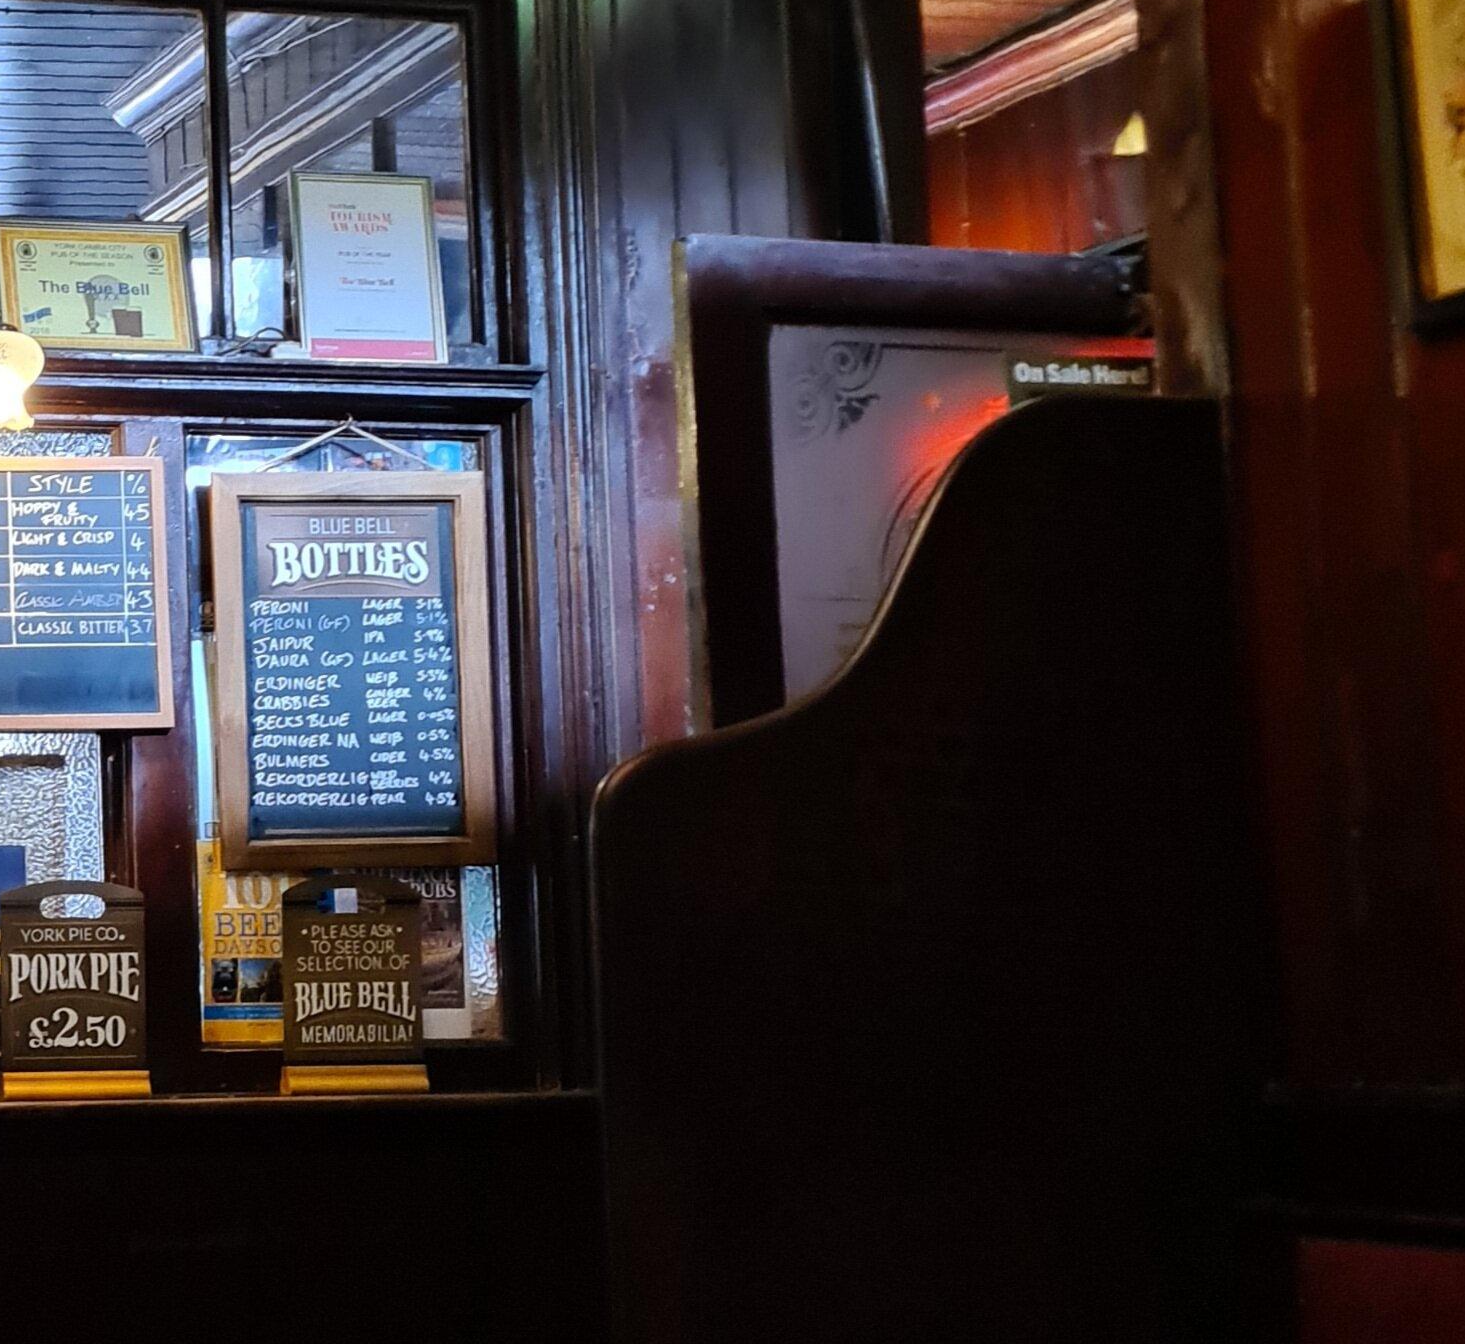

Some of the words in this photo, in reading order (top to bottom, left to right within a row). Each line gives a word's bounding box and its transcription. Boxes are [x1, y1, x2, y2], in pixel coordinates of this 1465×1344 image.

[38, 280, 70, 294] The
[76, 281, 114, 295] Blue
[118, 282, 150, 296] Bell
[28, 474, 94, 494] STYLE
[126, 473, 146, 495] %
[12, 502, 61, 517] HOPPY
[41, 513, 99, 529] FRUITY
[309, 518, 351, 536] BLUE
[354, 517, 396, 535] BELL
[12, 531, 54, 546] LIGHT
[72, 531, 115, 545] CRISP
[13, 561, 50, 578] DARK
[70, 562, 121, 577] MALTY
[268, 541, 430, 587] BOTTLES
[249, 600, 309, 616] PERONI
[362, 598, 404, 611] LAGER
[18, 622, 74, 635] CLASSIC
[79, 620, 125, 635] BITTER
[249, 617, 312, 634] PERONI
[362, 612, 404, 626] LAGER
[252, 635, 314, 654] JAIPUR
[364, 630, 385, 644] IPA
[255, 653, 309, 669] DAURA
[362, 650, 409, 666] LAGER
[254, 675, 342, 694] ERDINGER
[253, 694, 331, 711] CRABBIES
[253, 714, 304, 731] BECKS
[306, 712, 351, 728] BLUE
[253, 733, 333, 748] ERDINGER
[337, 733, 360, 749] NA
[253, 752, 330, 771] BULMERS
[255, 771, 369, 787] REKORDERLIG
[253, 791, 369, 807] REKORDERLIG
[20, 928, 66, 943] YORK
[68, 927, 92, 942] PIE
[311, 924, 367, 939] PLEASE
[370, 924, 395, 938] ASK
[311, 940, 331, 954] TO
[334, 940, 361, 955] SEE
[363, 939, 395, 954] OUR
[297, 956, 382, 972] SELECTION
[389, 954, 410, 971] OF
[8, 952, 88, 1002] PORK
[90, 951, 140, 1002] PIE
[294, 982, 353, 1023] BLUE
[357, 981, 416, 1022] BELL
[28, 1006, 127, 1049] £2.50
[301, 1024, 413, 1043] MEMORABILIA!
